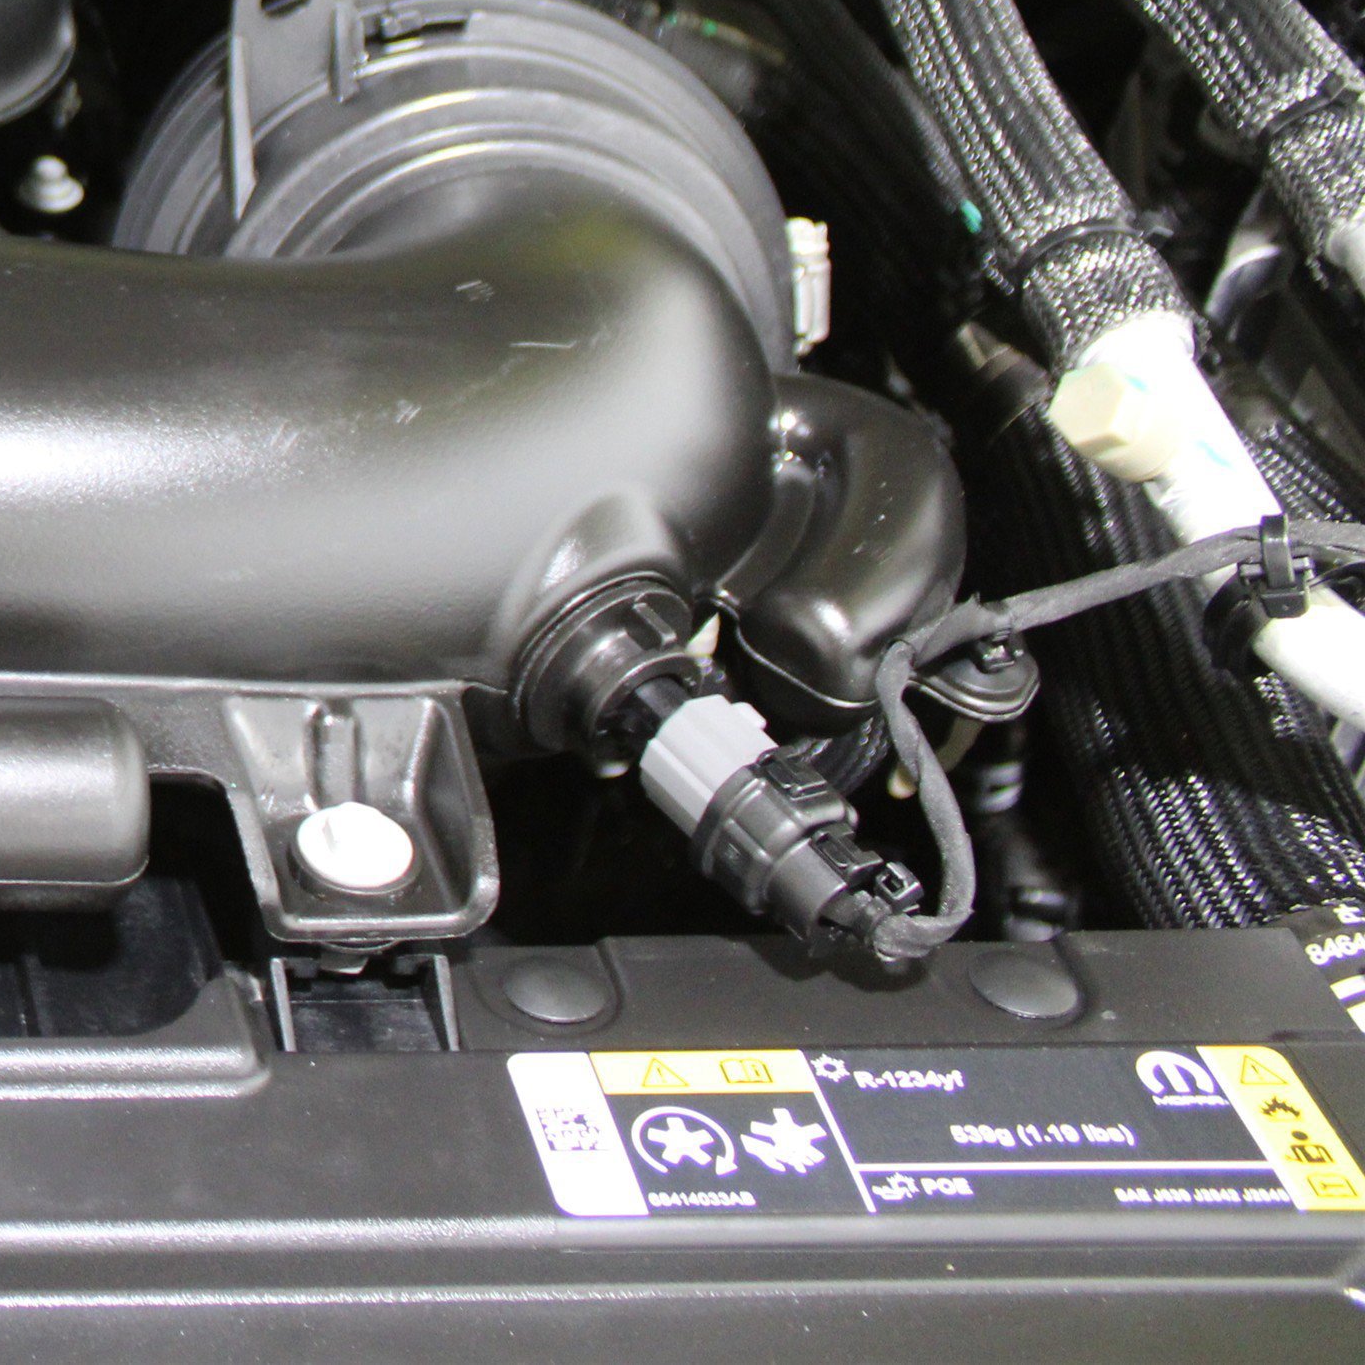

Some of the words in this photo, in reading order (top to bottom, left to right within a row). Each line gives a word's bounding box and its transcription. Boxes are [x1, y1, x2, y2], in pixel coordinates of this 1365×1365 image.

[854, 1069, 965, 1092] R-1234yf
[949, 1124, 1015, 1148] 539g
[1017, 1124, 1080, 1147] (1.19
[1080, 1124, 1135, 1147] lbs)
[921, 1177, 974, 1195] POE
